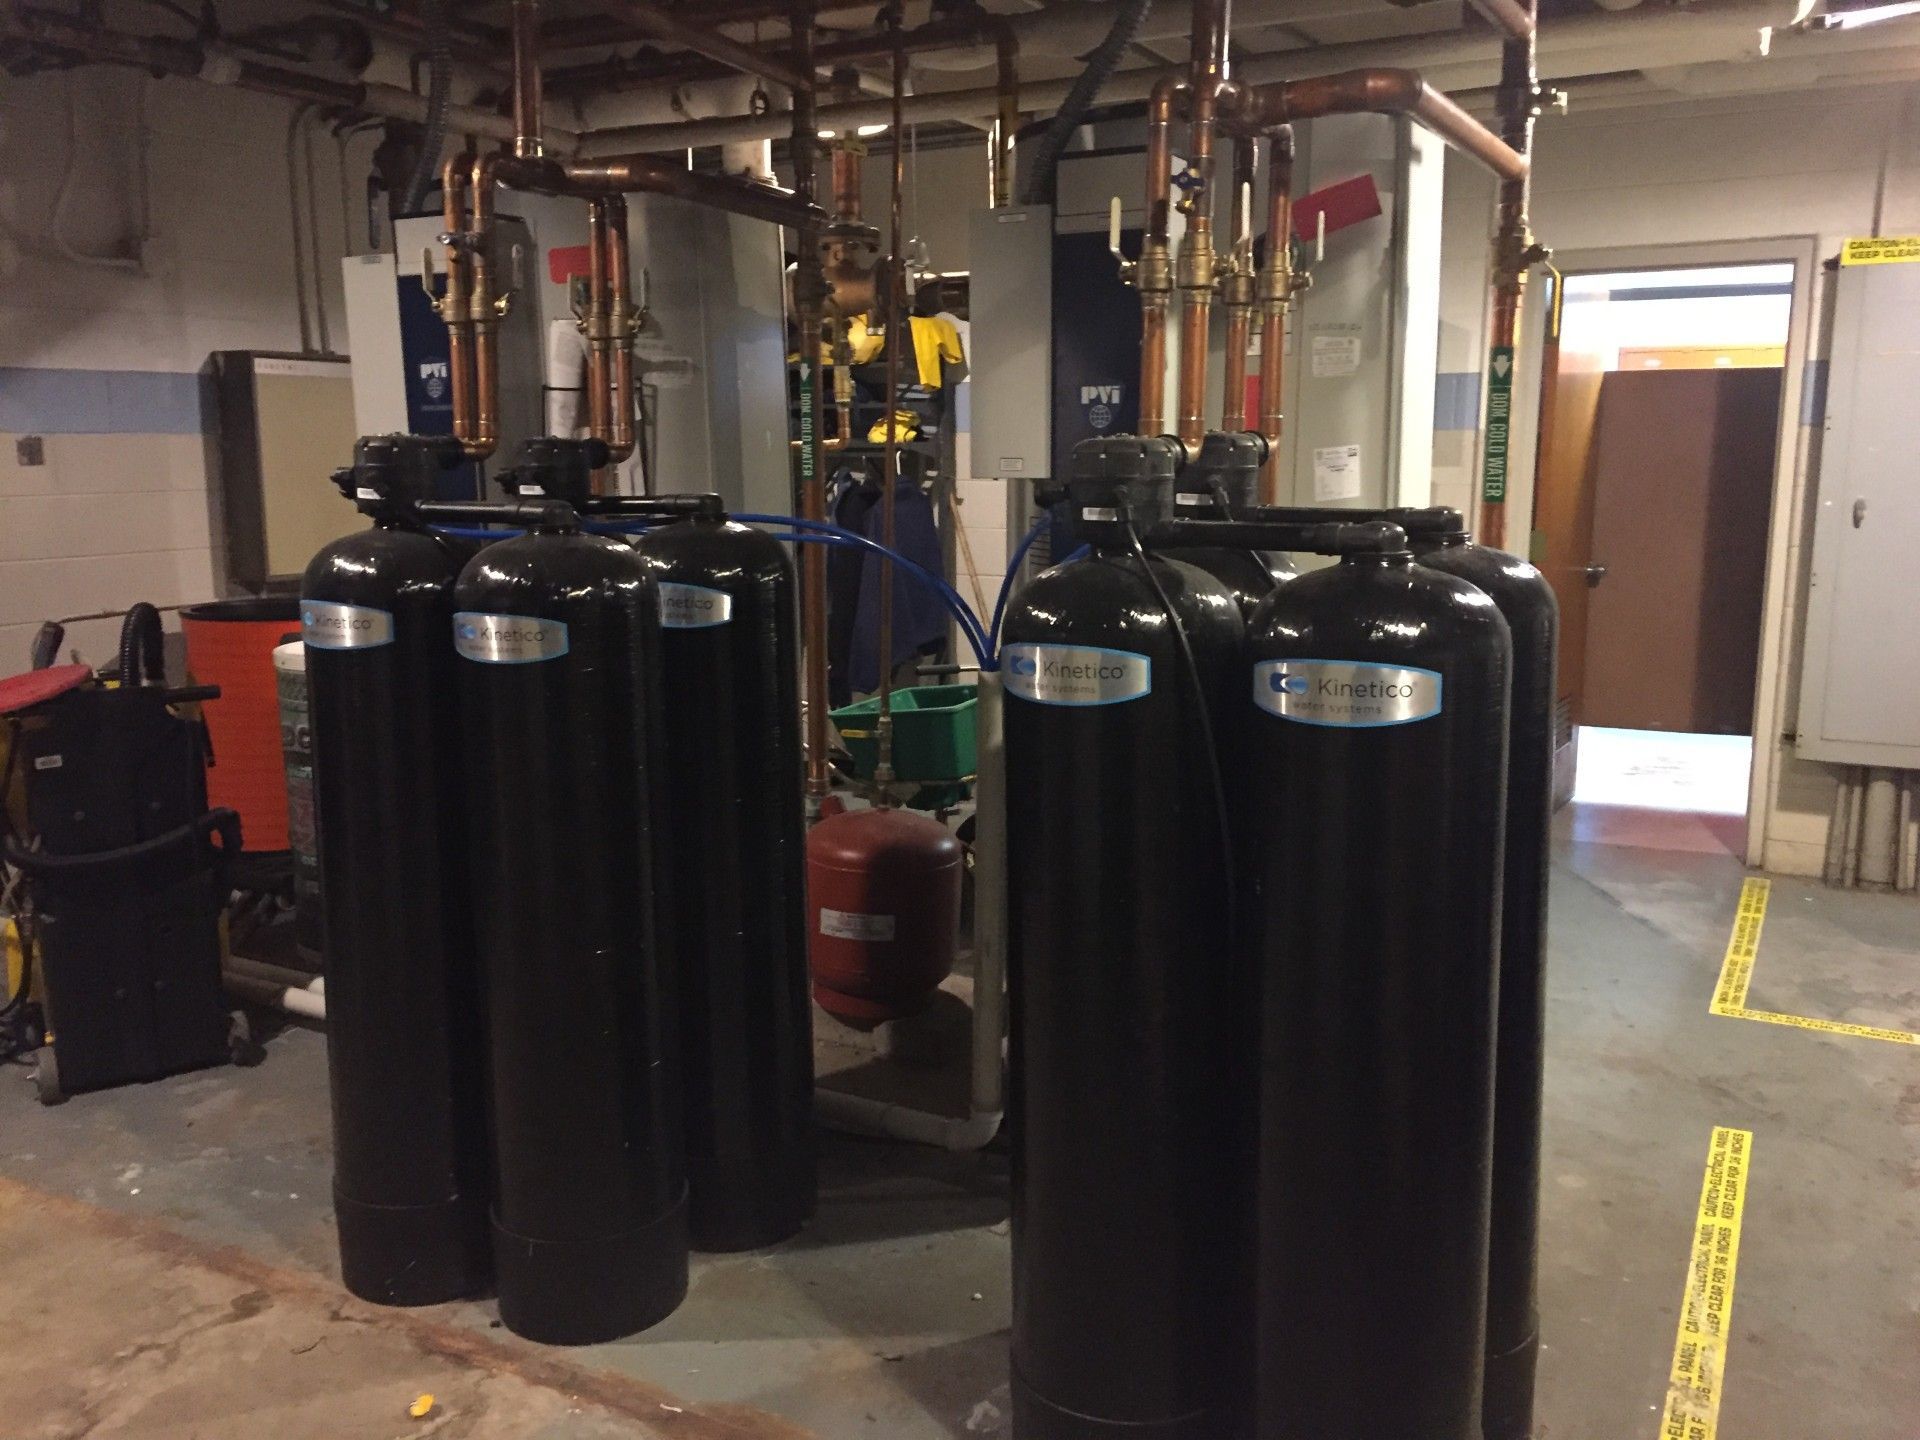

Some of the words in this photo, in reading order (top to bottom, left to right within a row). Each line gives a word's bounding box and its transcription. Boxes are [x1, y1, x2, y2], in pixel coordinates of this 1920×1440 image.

[1850, 250, 1880, 259] KEEP
[801, 417, 813, 442] COLD
[1488, 423, 1507, 453] COLD
[802, 444, 814, 477] WATER
[1485, 456, 1505, 497] WATER
[666, 595, 714, 610] netico
[480, 626, 545, 642] Knetico
[1043, 661, 1124, 680] Kinetico
[1318, 677, 1413, 698] Kinetico
[1329, 703, 1383, 715] systems
[1730, 1132, 1745, 1155] INCHES
[1728, 1165, 1740, 1179] FOR
[1724, 1179, 1738, 1201] CLEAR
[1721, 1201, 1735, 1219] KEEP
[1716, 1226, 1732, 1254] INCHES
[1711, 1267, 1727, 1285] FOR
[1708, 1284, 1724, 1312] CLEAR
[1678, 1341, 1697, 1373] PANEL
